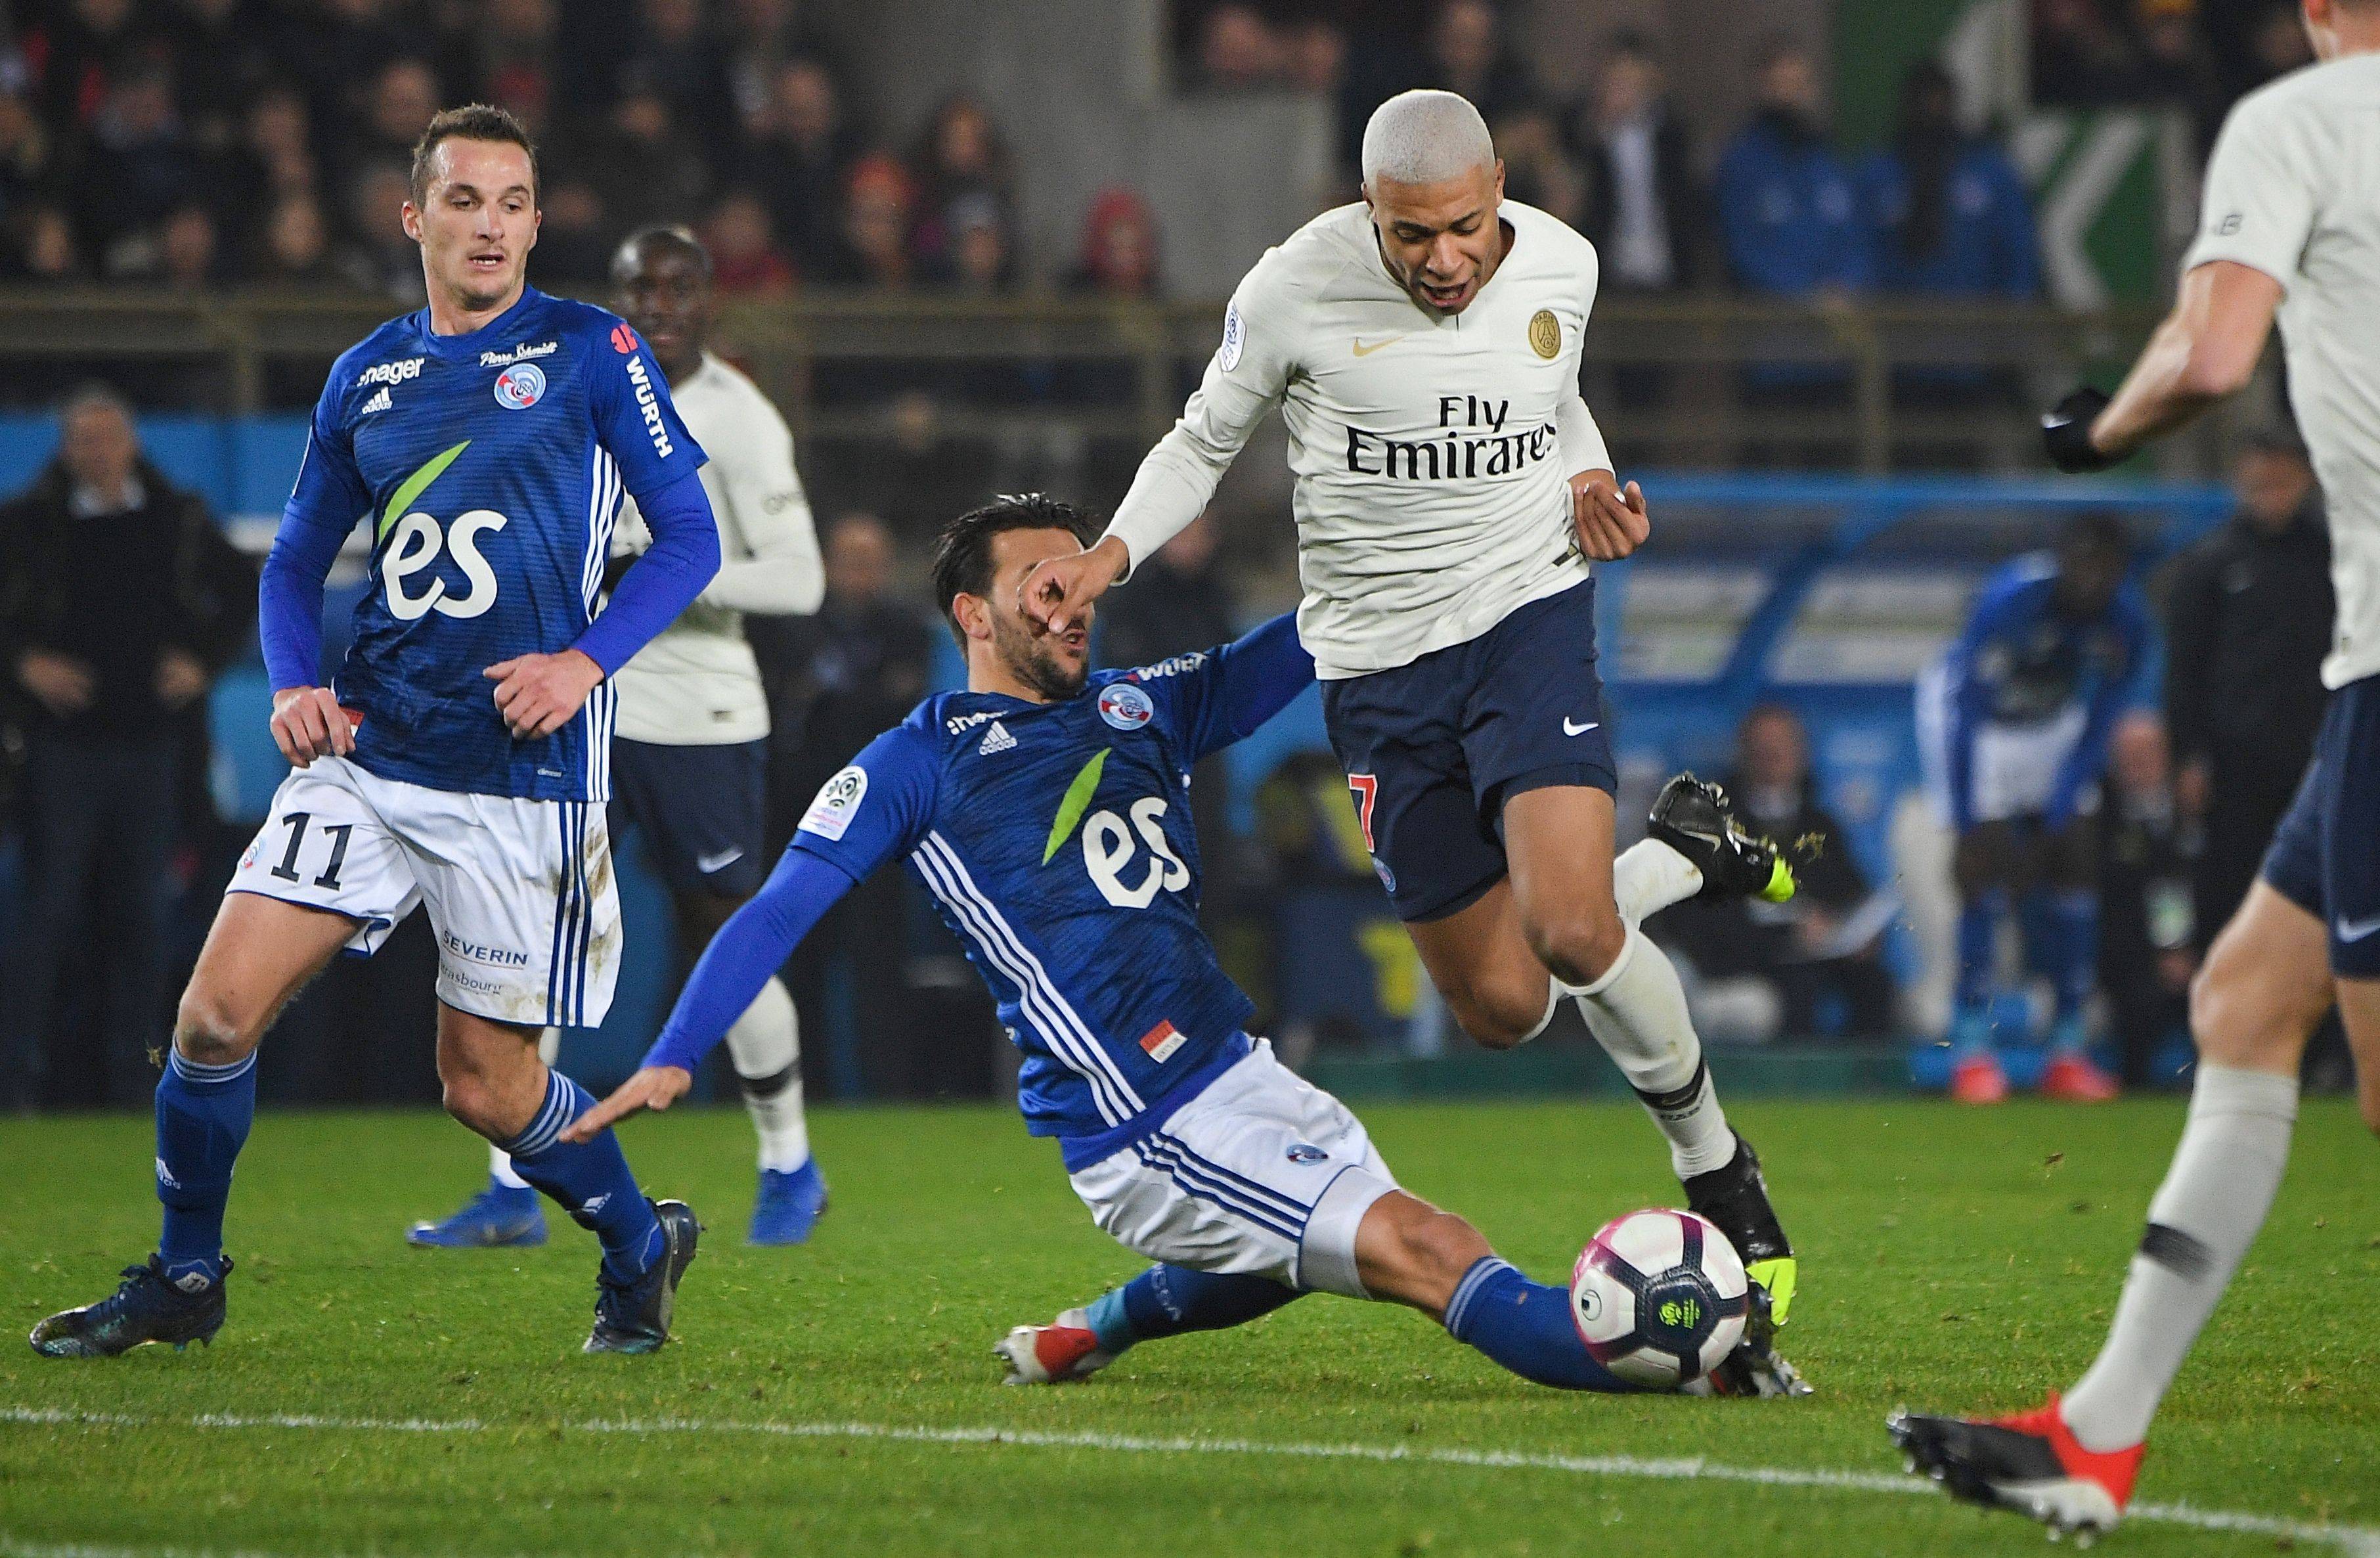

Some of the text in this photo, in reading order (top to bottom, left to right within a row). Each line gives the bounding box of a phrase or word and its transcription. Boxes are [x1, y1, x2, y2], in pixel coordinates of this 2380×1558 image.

[626, 355, 674, 459] WÜRTH
[1439, 395, 1509, 434] Fly
[381, 509, 508, 621] es
[270, 812, 354, 891] 11
[1082, 797, 1191, 910] es
[1348, 773, 1378, 854] 7
[443, 930, 528, 965] SEVERIN
